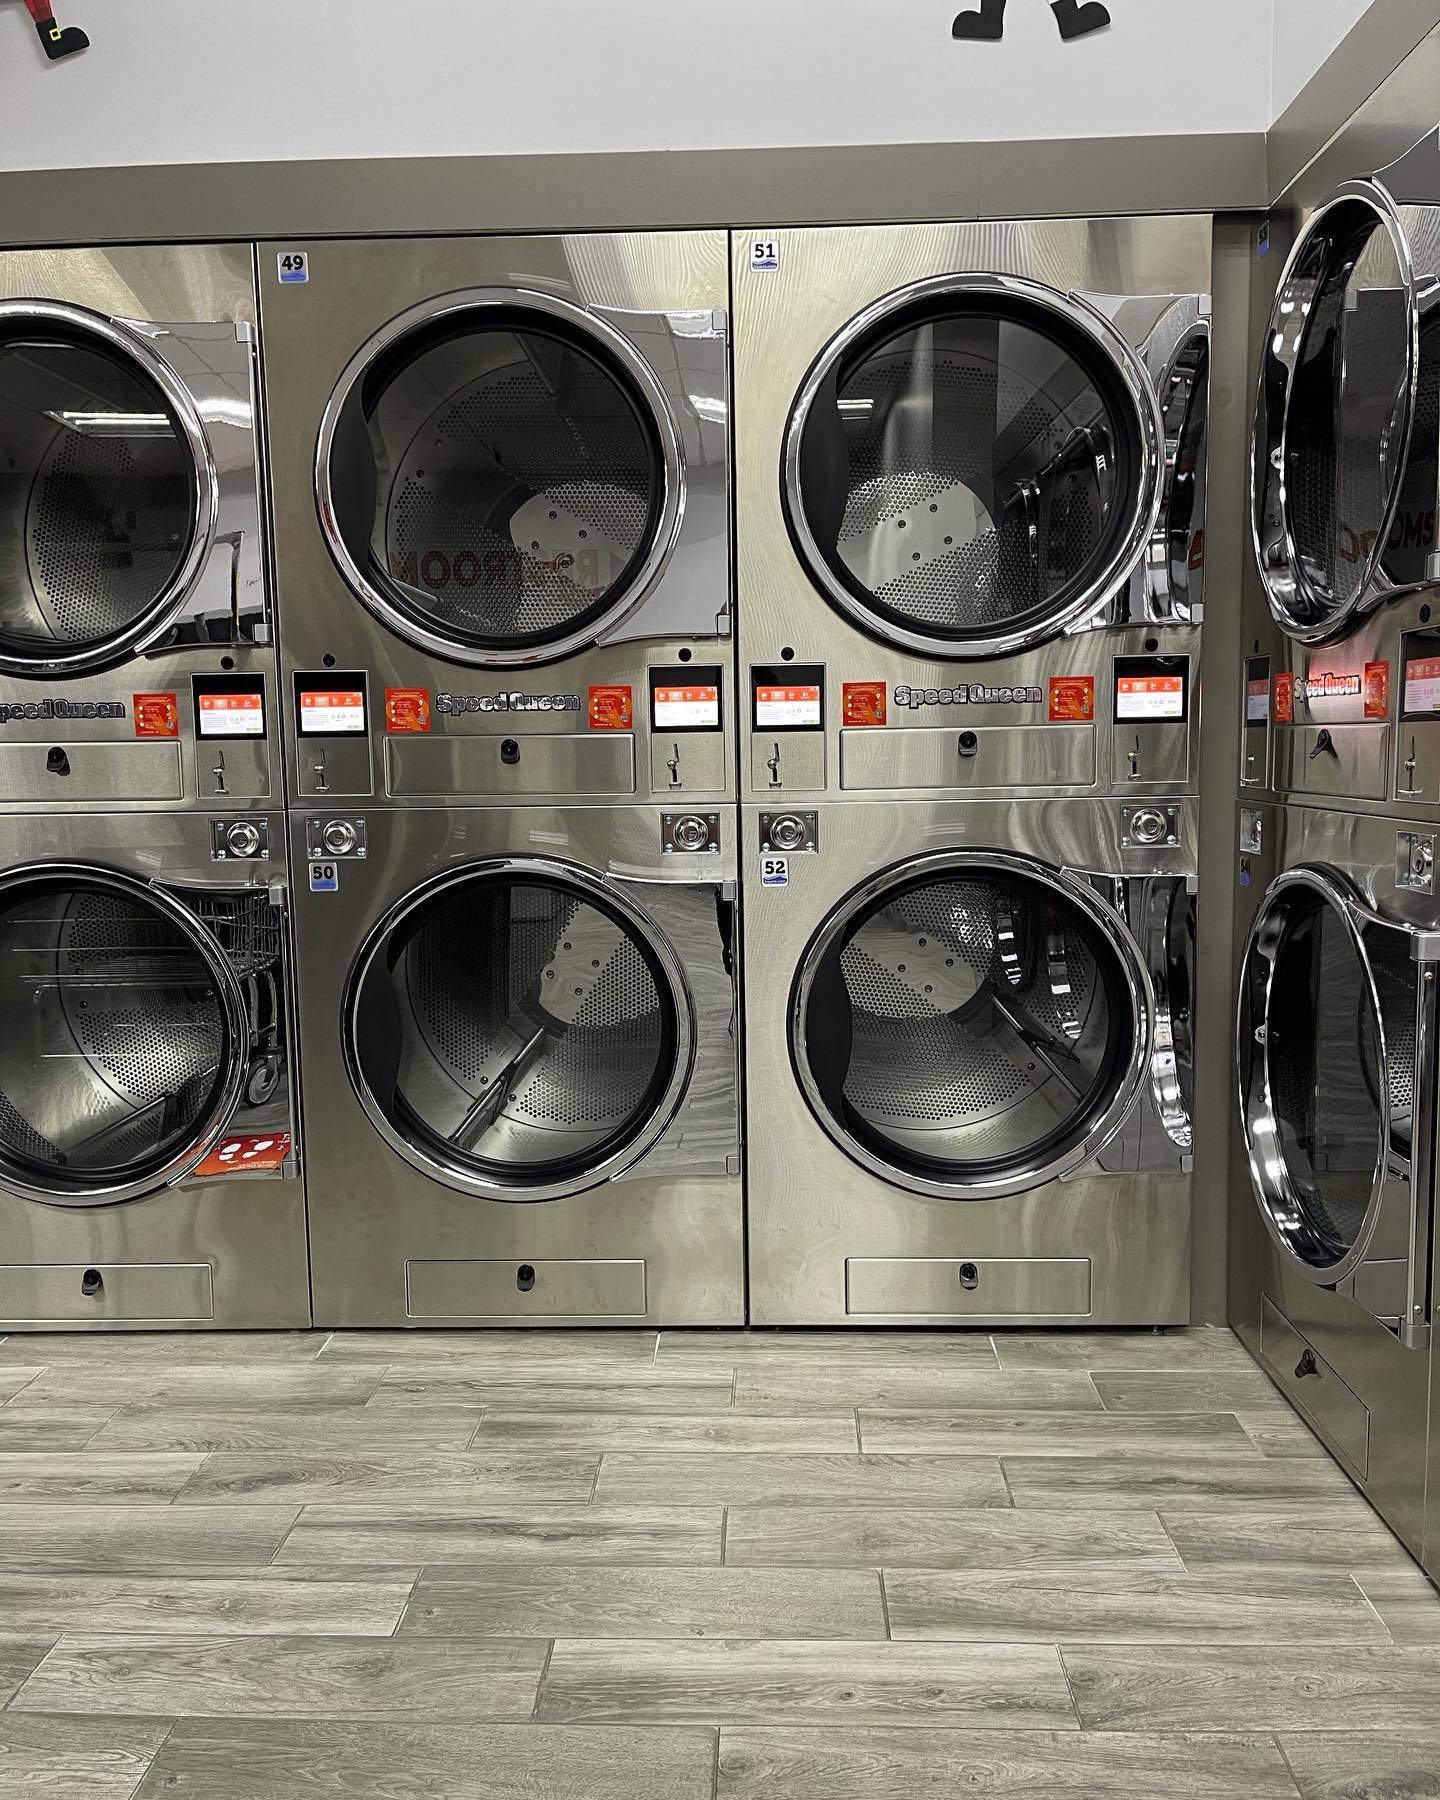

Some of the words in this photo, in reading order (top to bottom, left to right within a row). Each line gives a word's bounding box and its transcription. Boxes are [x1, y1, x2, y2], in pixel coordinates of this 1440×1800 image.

[755, 243, 776, 258] 51
[281, 254, 304, 270] 49
[312, 865, 334, 880] 50
[765, 860, 786, 875] 52
